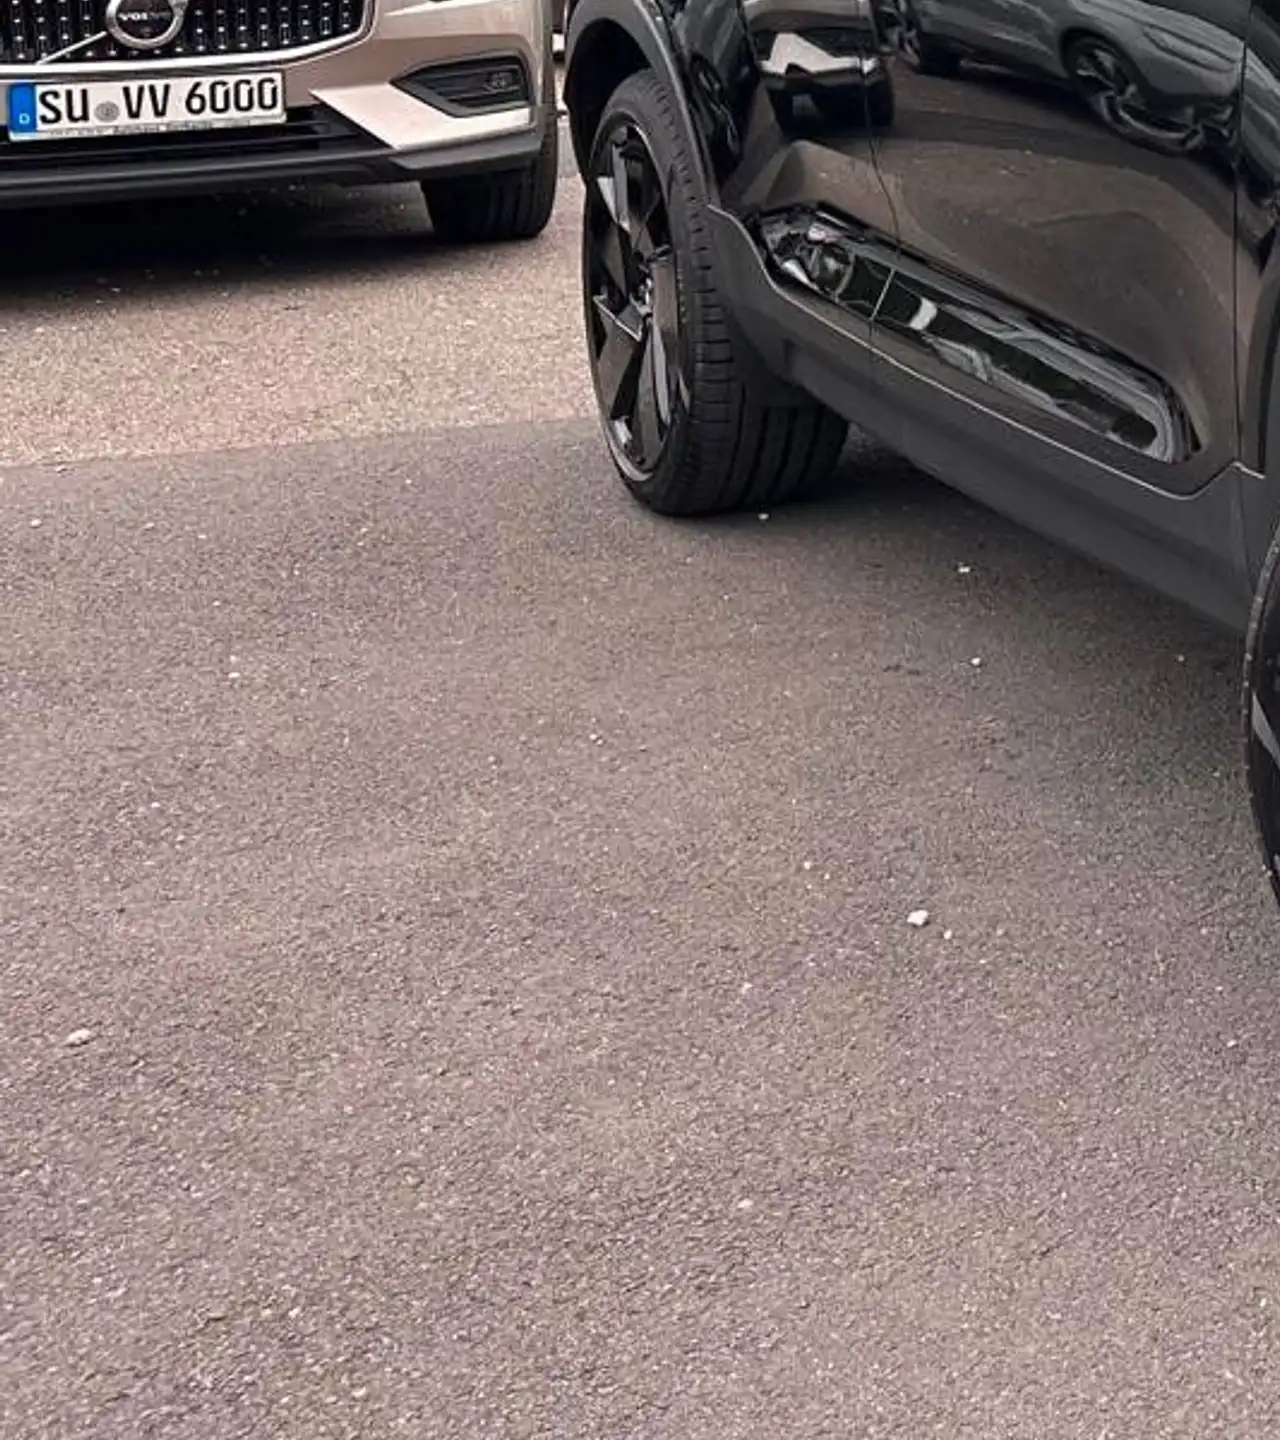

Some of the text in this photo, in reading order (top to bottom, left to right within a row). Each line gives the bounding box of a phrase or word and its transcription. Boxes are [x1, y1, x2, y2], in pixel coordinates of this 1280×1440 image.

[39, 77, 279, 125] SU VV 6000
[19, 113, 31, 125] D
